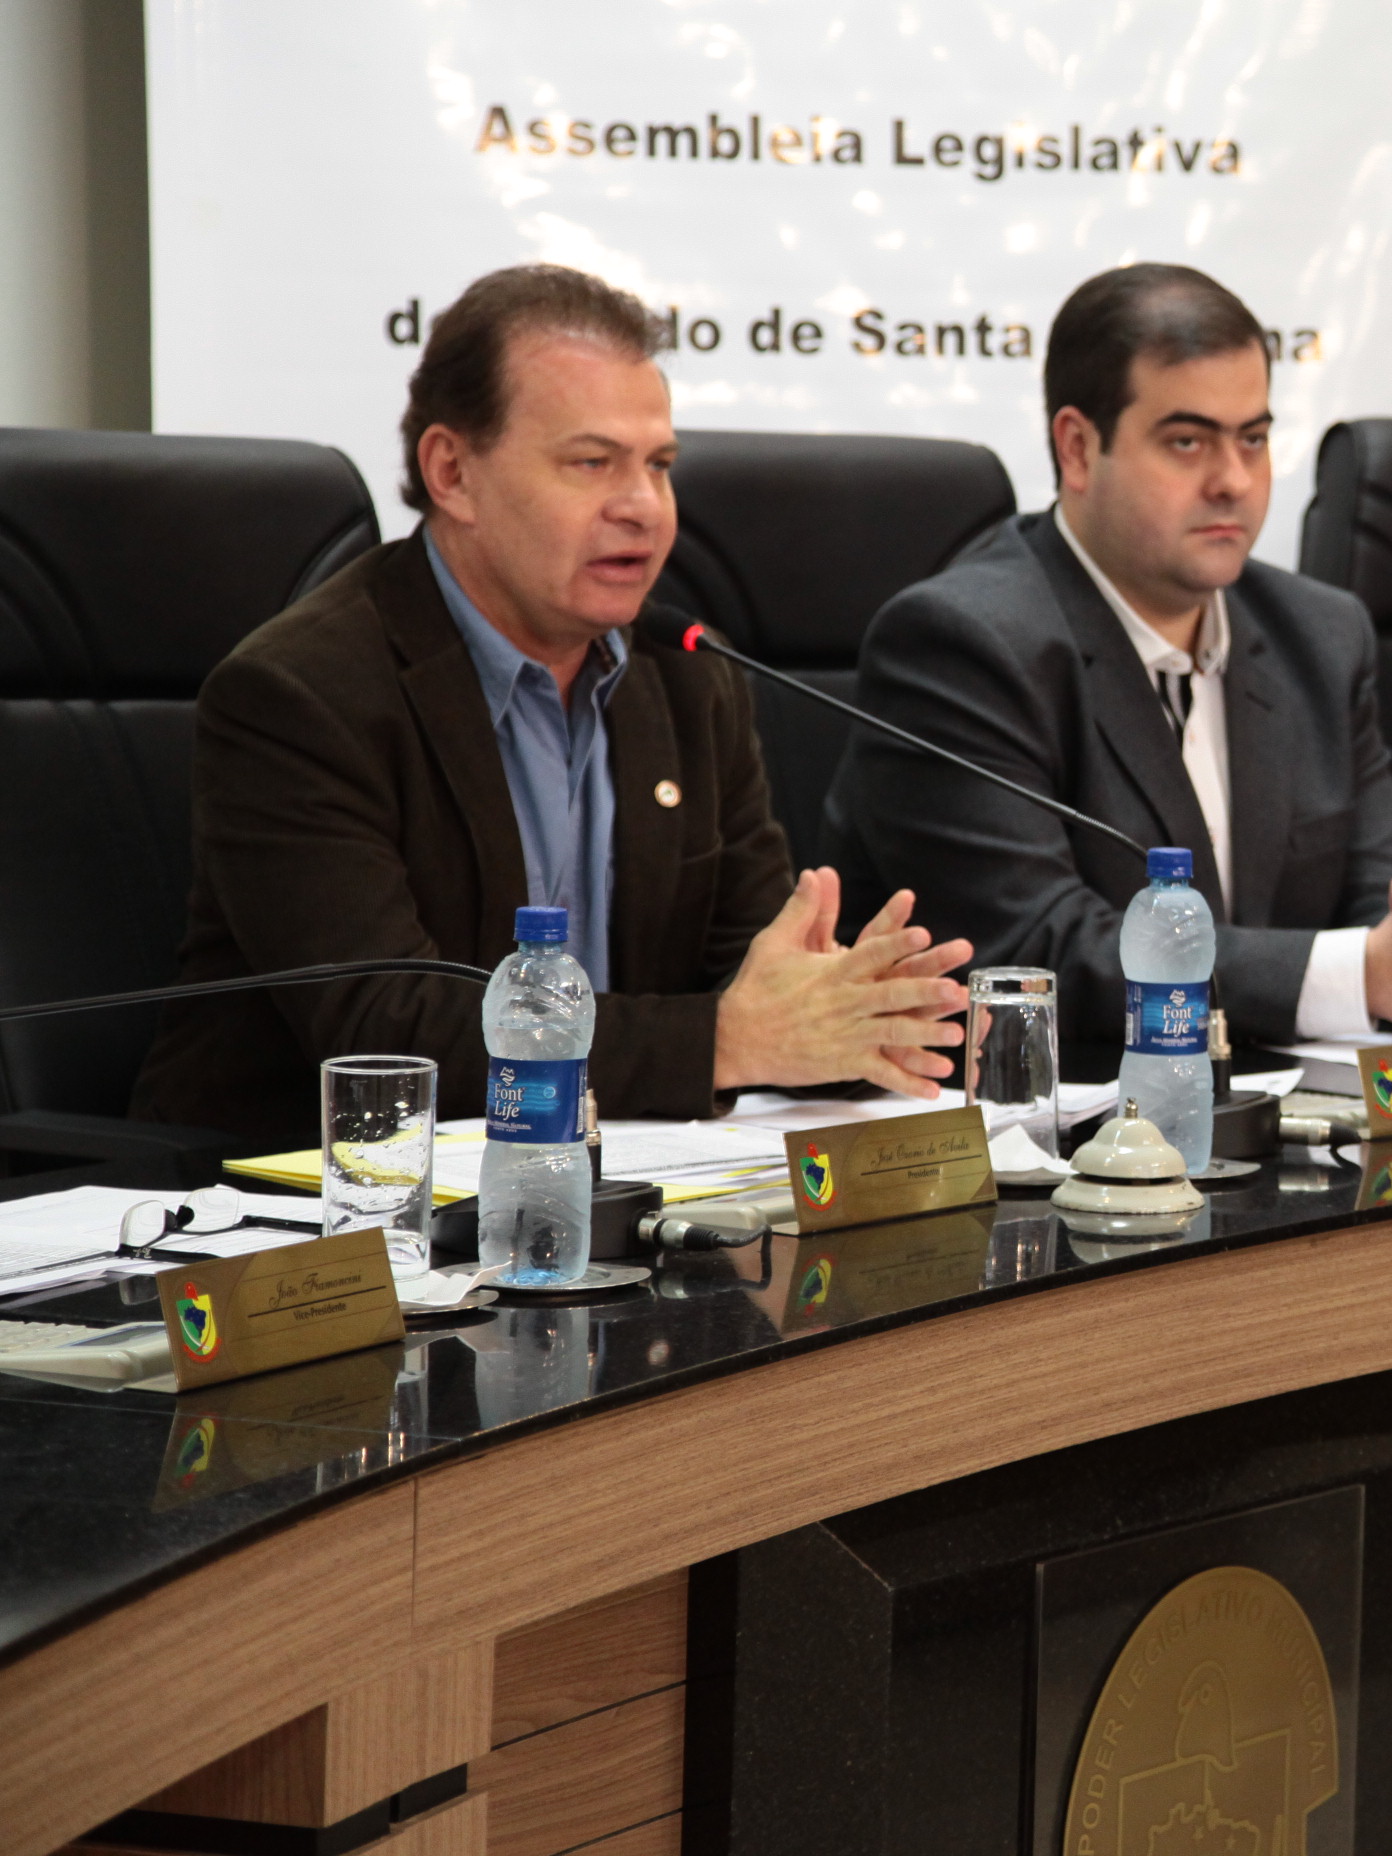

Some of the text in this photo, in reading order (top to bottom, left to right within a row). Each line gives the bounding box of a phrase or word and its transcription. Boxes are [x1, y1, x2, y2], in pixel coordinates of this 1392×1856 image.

[474, 104, 1241, 182] Assembleia Legislativa
[747, 306, 824, 354] de
[850, 307, 1034, 359] Santa
[1163, 1004, 1193, 1019] Font
[1162, 1019, 1190, 1038] Life
[494, 1083, 524, 1101] Font
[494, 1100, 520, 1121] Life
[268, 1279, 298, 1310] João
[293, 1301, 347, 1321] Vice-Presidente
[1076, 1588, 1328, 1856] PODER LEGISLATIVO MUNICIPAL
